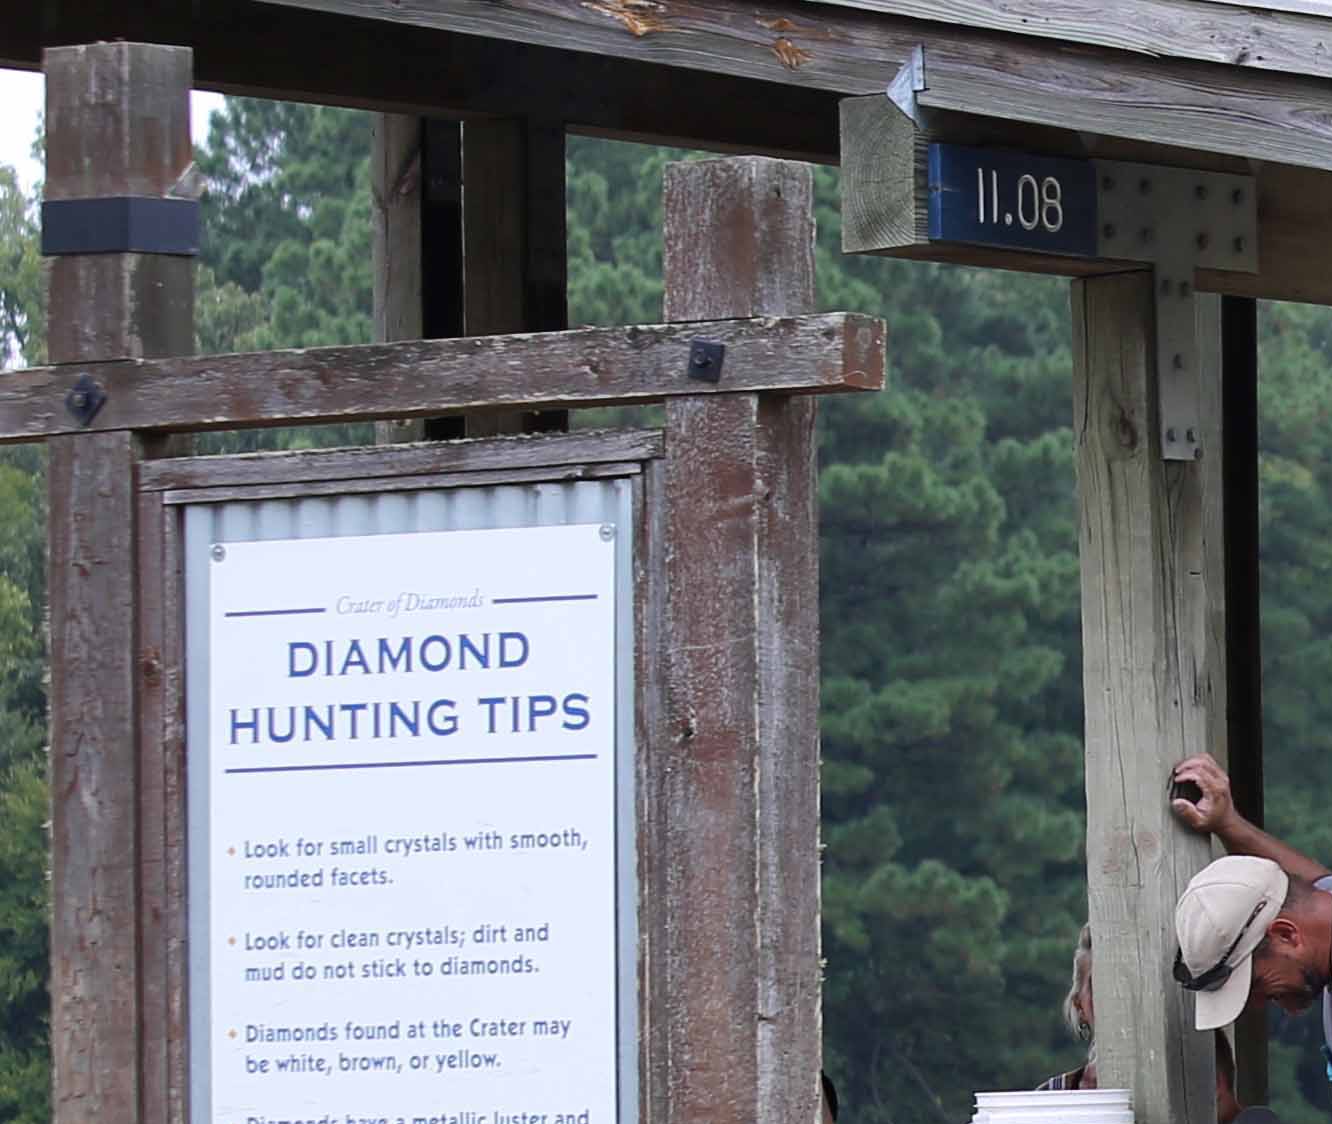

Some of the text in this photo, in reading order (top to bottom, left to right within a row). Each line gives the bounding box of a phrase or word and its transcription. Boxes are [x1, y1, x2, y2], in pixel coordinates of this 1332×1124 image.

[976, 167, 1064, 233] 11.08
[335, 588, 484, 618] Crater of Diamonds
[288, 632, 529, 678] DIAMOND
[230, 693, 590, 744] HUNTING TIPS
[244, 828, 587, 858] Look for small crystals with smooth,
[245, 867, 394, 889] rounded facets.
[245, 923, 549, 951] Look for clean crystals; dirt and
[245, 954, 539, 981] mud do not stick to diamonds.
[245, 1018, 571, 1043] Diamonds found at the Crater may
[246, 1049, 501, 1076] be white, brown, or yellow.
